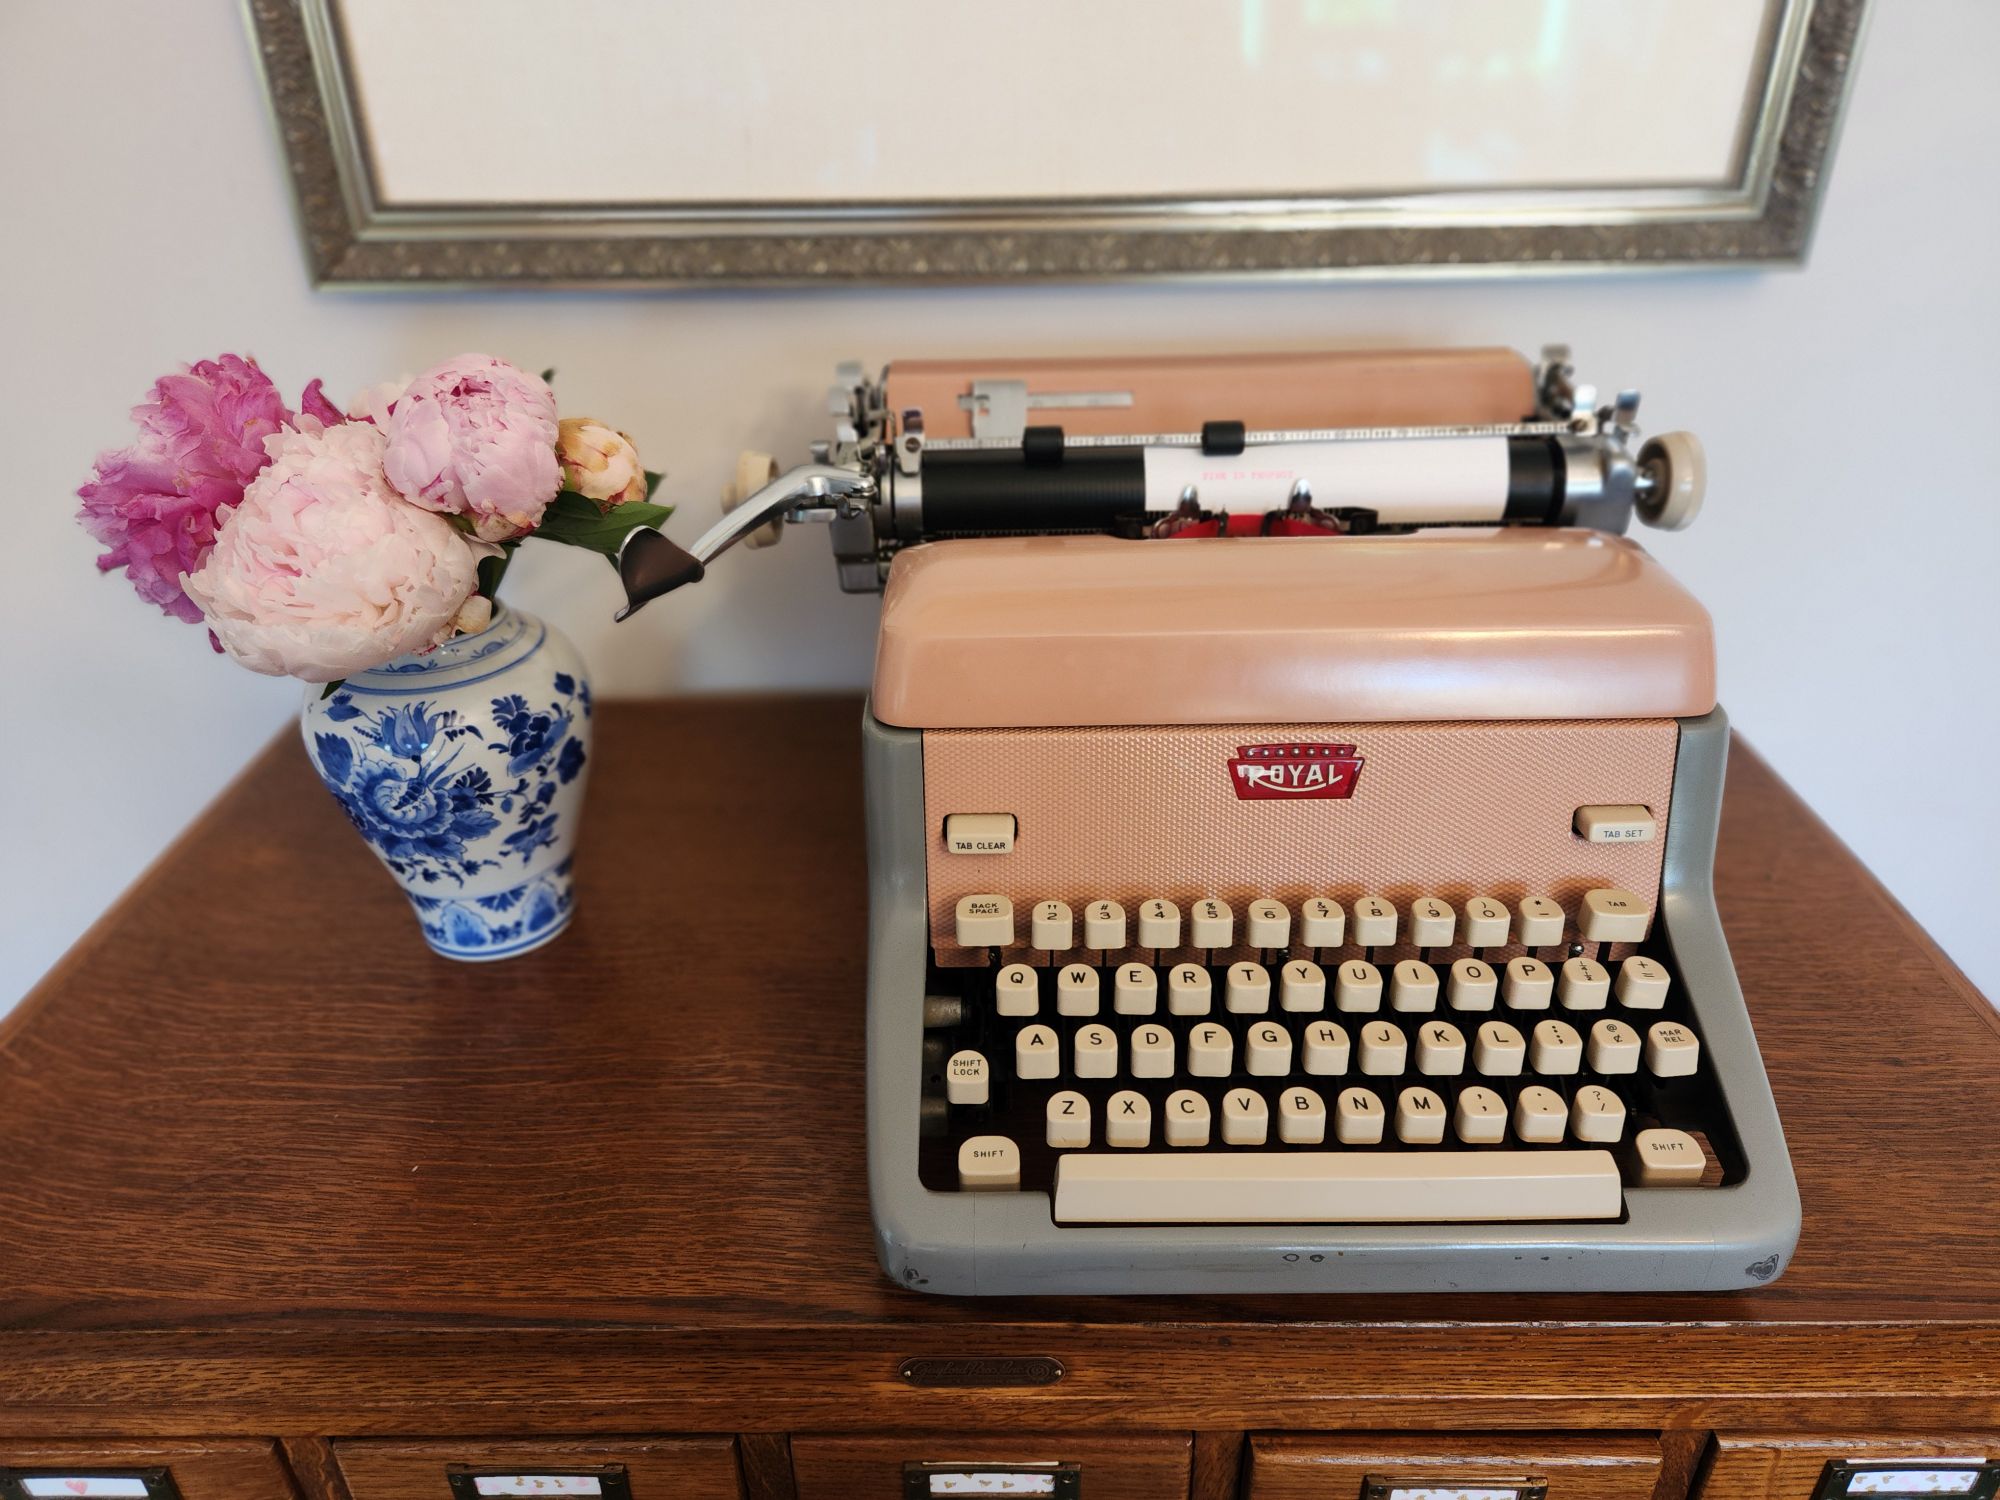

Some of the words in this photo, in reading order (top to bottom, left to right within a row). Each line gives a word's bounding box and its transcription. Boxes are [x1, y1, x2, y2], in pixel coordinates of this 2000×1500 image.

[1236, 764, 1344, 793] ROYAL
[1625, 829, 1643, 838] SET
[1205, 902, 1216, 911] %
[1370, 908, 1383, 916] 8
[1047, 912, 1057, 920] 2
[1100, 912, 1111, 920] 3
[1154, 910, 1165, 919] 4
[1207, 910, 1218, 919] 5
[1264, 910, 1276, 919] 6
[1318, 909, 1329, 918] 7
[1428, 909, 1440, 918] 9
[1482, 910, 1496, 918] 0
[1522, 964, 1536, 976] P
[1638, 961, 1648, 969] +
[1010, 972, 1024, 984] Q
[1071, 972, 1086, 984] W
[1129, 970, 1142, 983] E
[1182, 971, 1196, 983] R
[1241, 969, 1254, 981] T
[1295, 967, 1308, 979] Y
[1352, 968, 1367, 980] U
[1412, 968, 1419, 980] I
[1466, 966, 1481, 978] O
[1606, 1024, 1618, 1033] @
[1030, 1033, 1044, 1046] A
[1090, 1032, 1102, 1045] S
[1146, 1032, 1159, 1045] D
[1204, 1031, 1217, 1044] F
[1261, 1030, 1278, 1043] G
[1319, 1029, 1335, 1041] H
[1378, 1029, 1390, 1042] J
[1433, 1030, 1450, 1042] K
[1493, 1030, 1509, 1043] L
[952, 1058, 982, 1067] SHIFT
[1592, 1090, 1601, 1101] ?
[1062, 1100, 1074, 1115] Z
[1123, 1100, 1135, 1114] X
[1180, 1099, 1195, 1114] C
[1237, 1098, 1250, 1111] V
[1294, 1096, 1310, 1110] B
[1352, 1096, 1369, 1110] N
[1412, 1096, 1431, 1110] M
